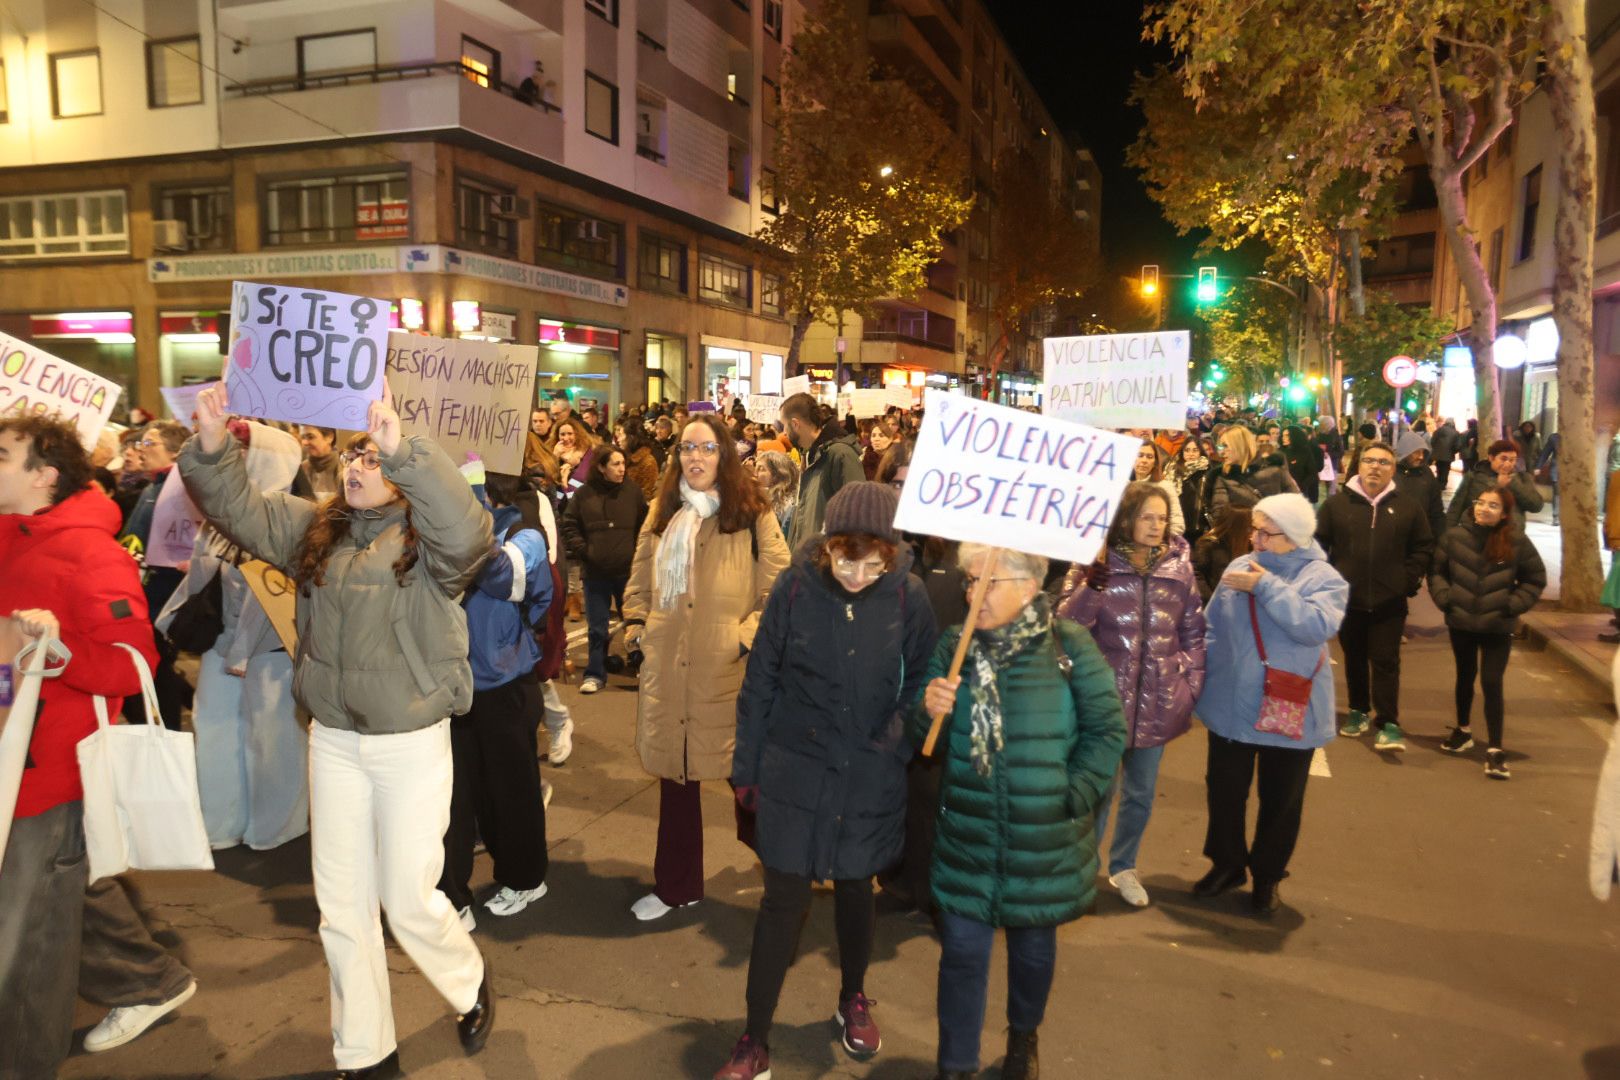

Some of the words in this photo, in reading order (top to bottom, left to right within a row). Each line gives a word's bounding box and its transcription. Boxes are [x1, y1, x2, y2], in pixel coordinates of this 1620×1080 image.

[176, 260, 255, 277] PROMOCIONES
[267, 256, 334, 274] CONTRATAS
[339, 253, 376, 271] CURTO
[464, 255, 527, 284] PROMOCIONES
[535, 271, 578, 294] CONTRATAS
[257, 287, 290, 327] SÍ
[302, 292, 338, 331] TE
[269, 329, 379, 391] CREO
[459, 353, 533, 389] MACHISTA
[1052, 336, 1165, 365] VIOLENCIA
[0, 340, 106, 414] IOLENCIA
[1050, 372, 1181, 409] PATRIMONIAL
[436, 396, 522, 453] FEMINISTA
[940, 405, 1117, 481] VIOLENCIA
[919, 468, 1111, 539] OBSTÉTRICA
